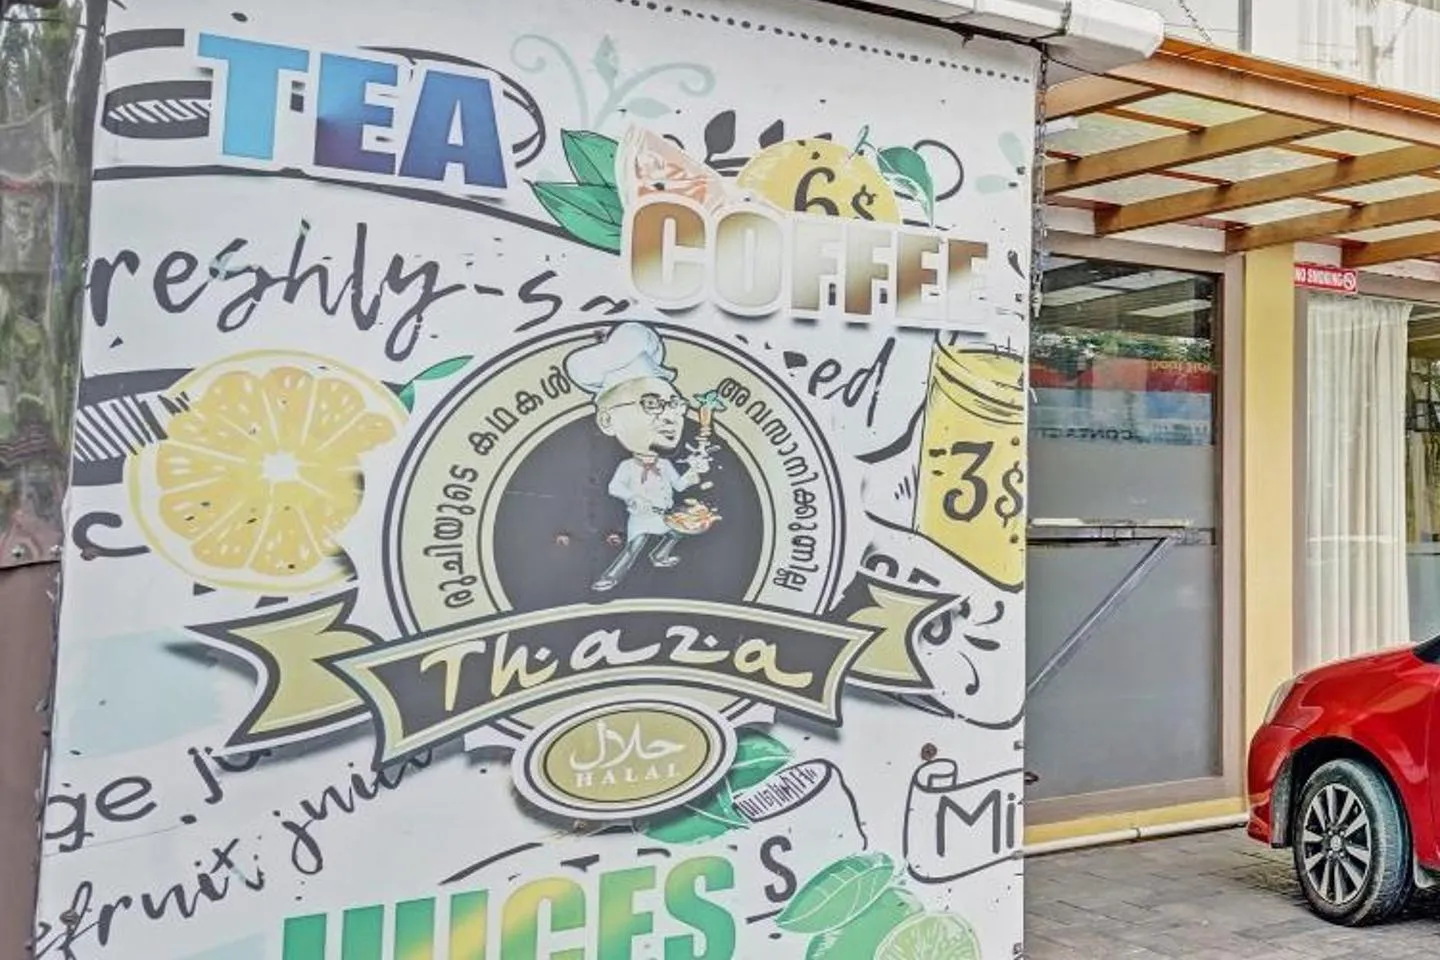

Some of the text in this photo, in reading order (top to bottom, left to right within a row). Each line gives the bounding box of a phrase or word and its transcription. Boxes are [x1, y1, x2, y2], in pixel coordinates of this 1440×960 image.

[198, 32, 508, 189] TEA
[630, 199, 990, 323] COFFEE
[419, 619, 813, 713] Thaza
[569, 718, 687, 771] حلال
[575, 762, 682, 788] HALAL
